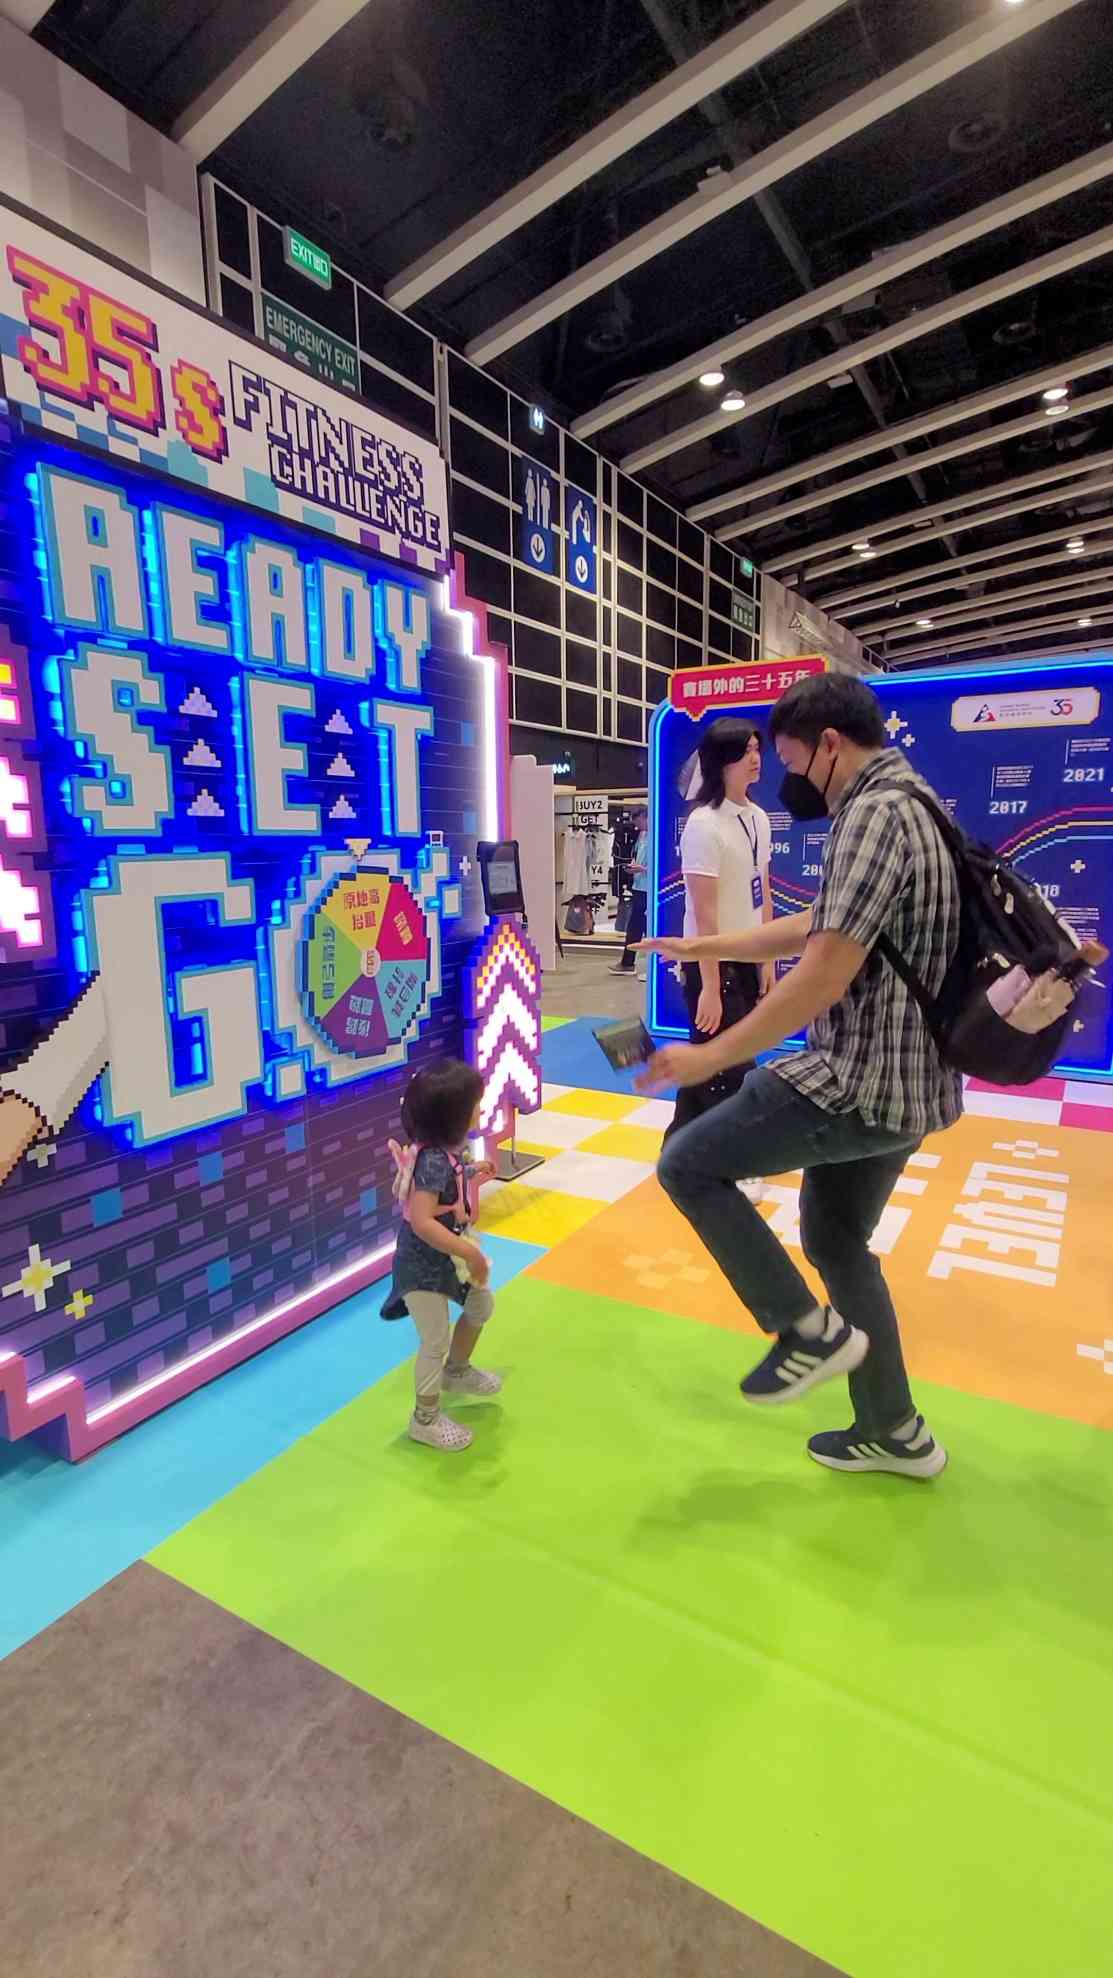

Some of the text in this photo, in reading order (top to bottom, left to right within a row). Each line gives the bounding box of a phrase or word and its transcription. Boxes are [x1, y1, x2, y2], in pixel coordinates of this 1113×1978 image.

[265, 305, 333, 362] EMERGENCY
[335, 347, 356, 377] EXIT
[228, 360, 425, 507] FITNESS
[268, 442, 442, 552] CHALLENGE
[36, 462, 432, 695] READY
[988, 800, 1029, 815] 2017
[1063, 767, 1105, 783] 2021
[926, 1161, 1070, 1288] LEVEL
